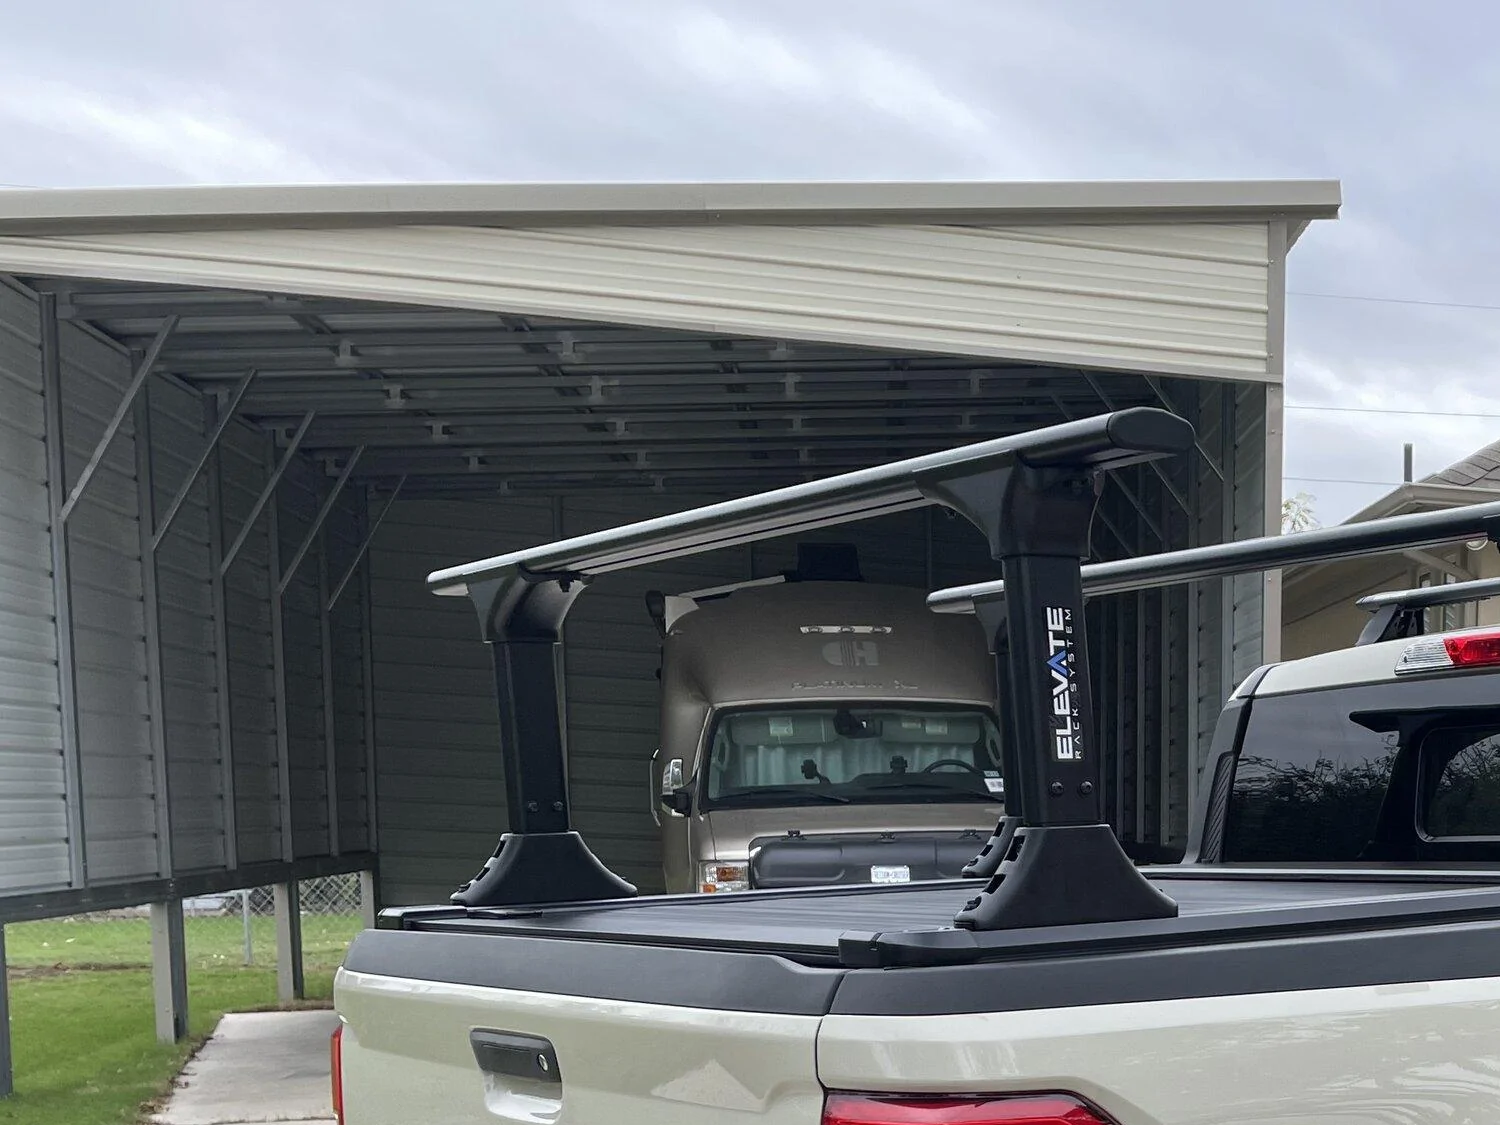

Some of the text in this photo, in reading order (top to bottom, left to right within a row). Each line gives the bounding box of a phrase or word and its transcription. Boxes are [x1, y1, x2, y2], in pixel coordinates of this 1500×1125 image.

[1046, 606, 1074, 760] ELEVATE
[1064, 608, 1082, 760] RACK SYSTEM
